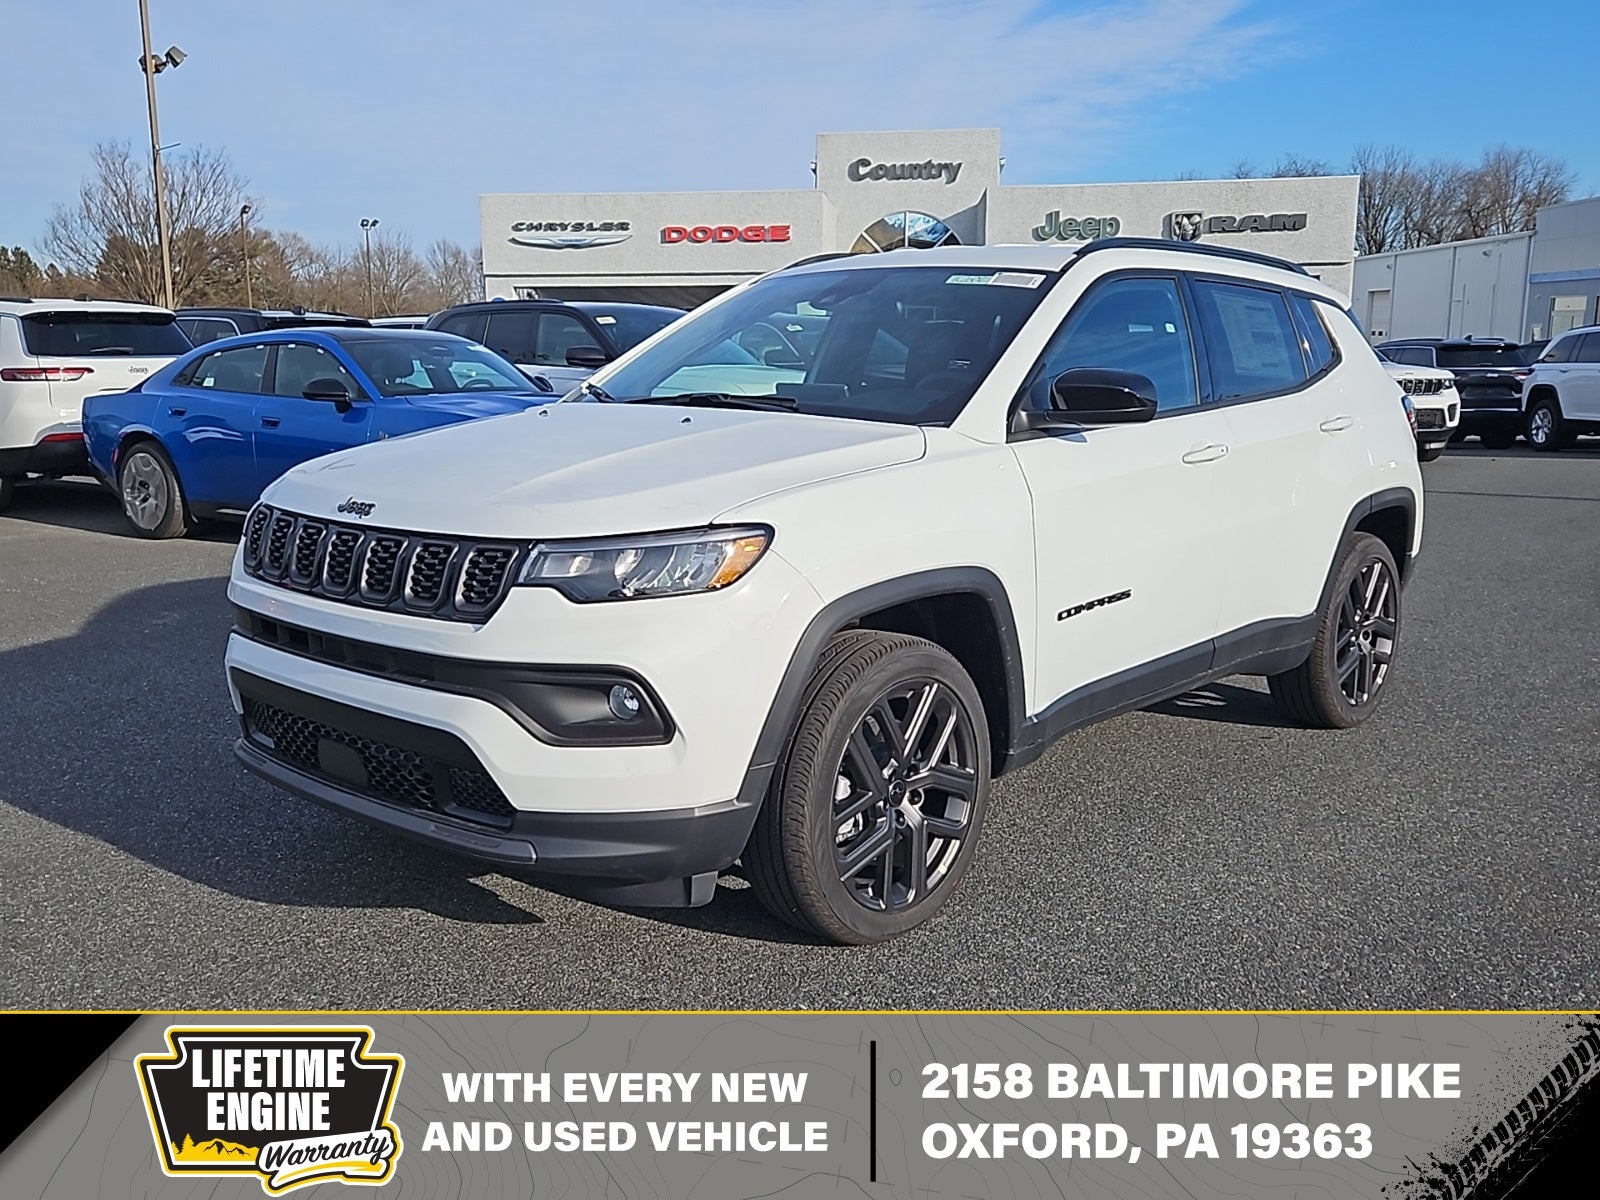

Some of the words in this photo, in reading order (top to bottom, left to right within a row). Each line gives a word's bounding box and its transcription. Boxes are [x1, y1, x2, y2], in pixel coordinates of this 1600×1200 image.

[848, 158, 963, 184] Country
[511, 220, 631, 233] CHRYSLER
[661, 224, 791, 244] DODGE
[1032, 210, 1121, 240] Jeep
[1206, 213, 1307, 234] RAM
[337, 496, 376, 519] Jeep
[1057, 588, 1132, 622] COMPASS
